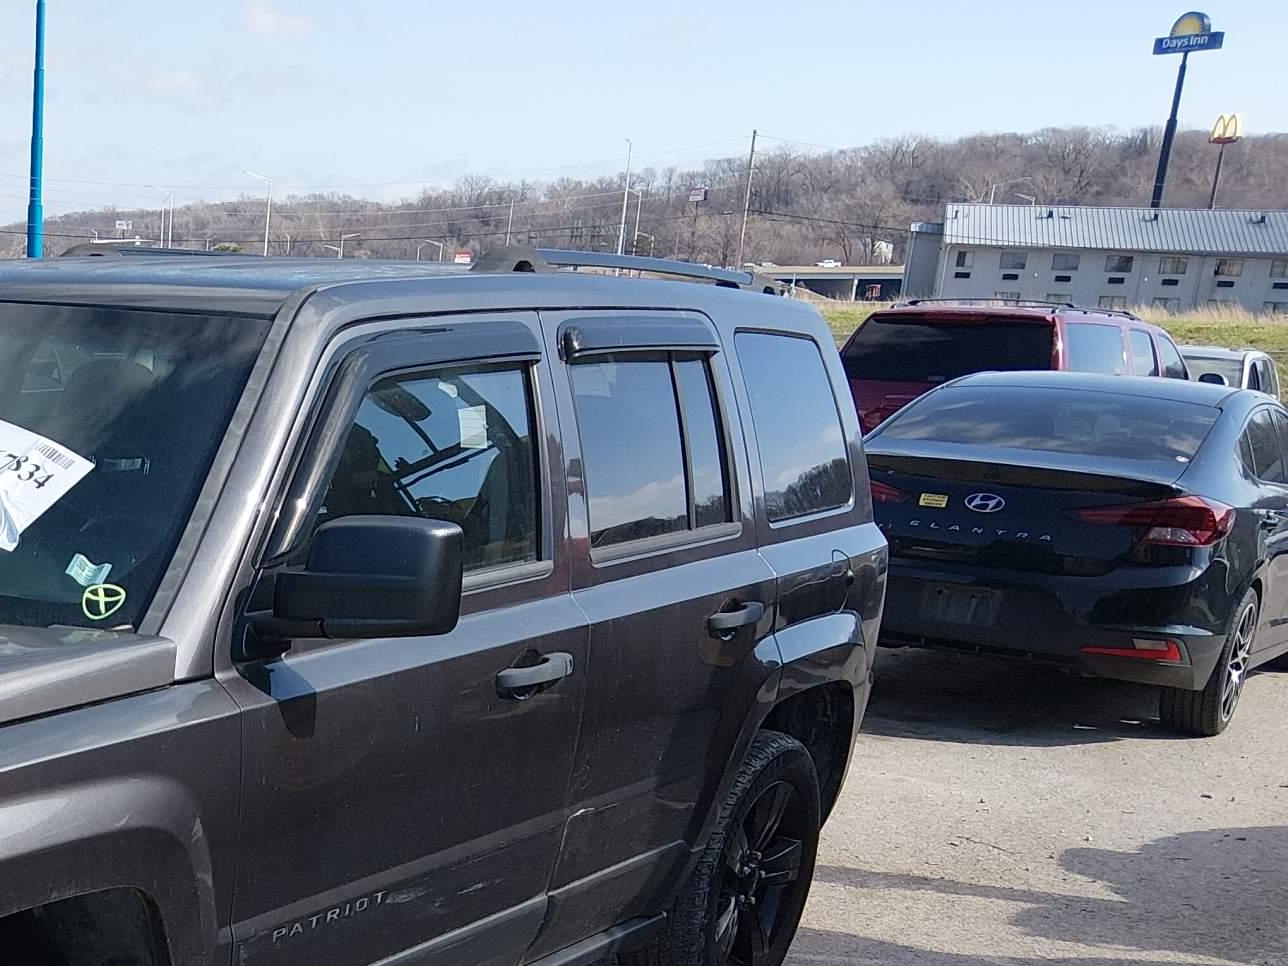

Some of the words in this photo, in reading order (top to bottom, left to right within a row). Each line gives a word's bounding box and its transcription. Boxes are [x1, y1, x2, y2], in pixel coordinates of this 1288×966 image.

[1161, 37, 1189, 50] Days
[1190, 35, 1209, 46] Inn
[909, 519, 1053, 542] ELANTRA
[272, 889, 388, 943] PATRIOT
